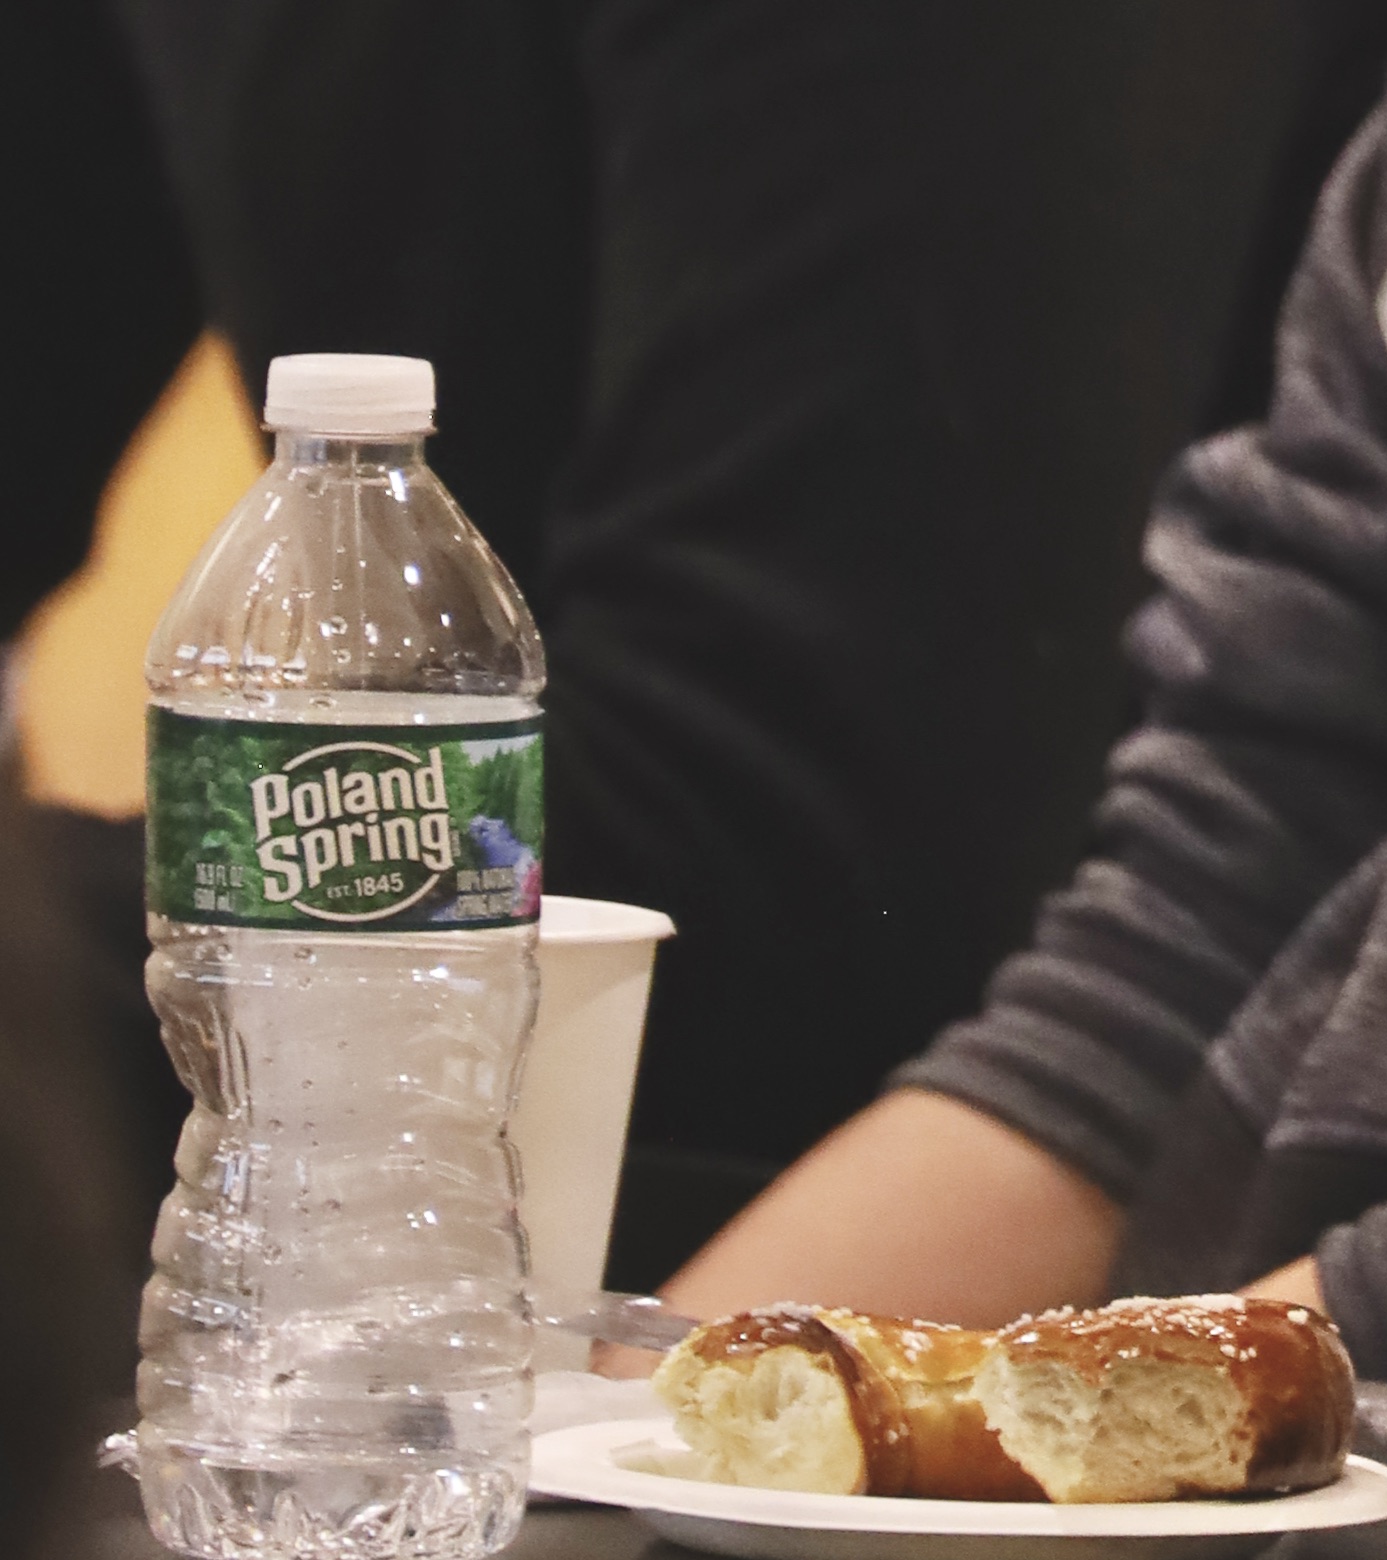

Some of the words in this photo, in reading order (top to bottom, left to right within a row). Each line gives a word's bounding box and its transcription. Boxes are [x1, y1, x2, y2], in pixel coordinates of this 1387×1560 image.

[250, 746, 449, 841] Poland
[256, 812, 454, 902] Spring
[354, 872, 404, 897] 1845
